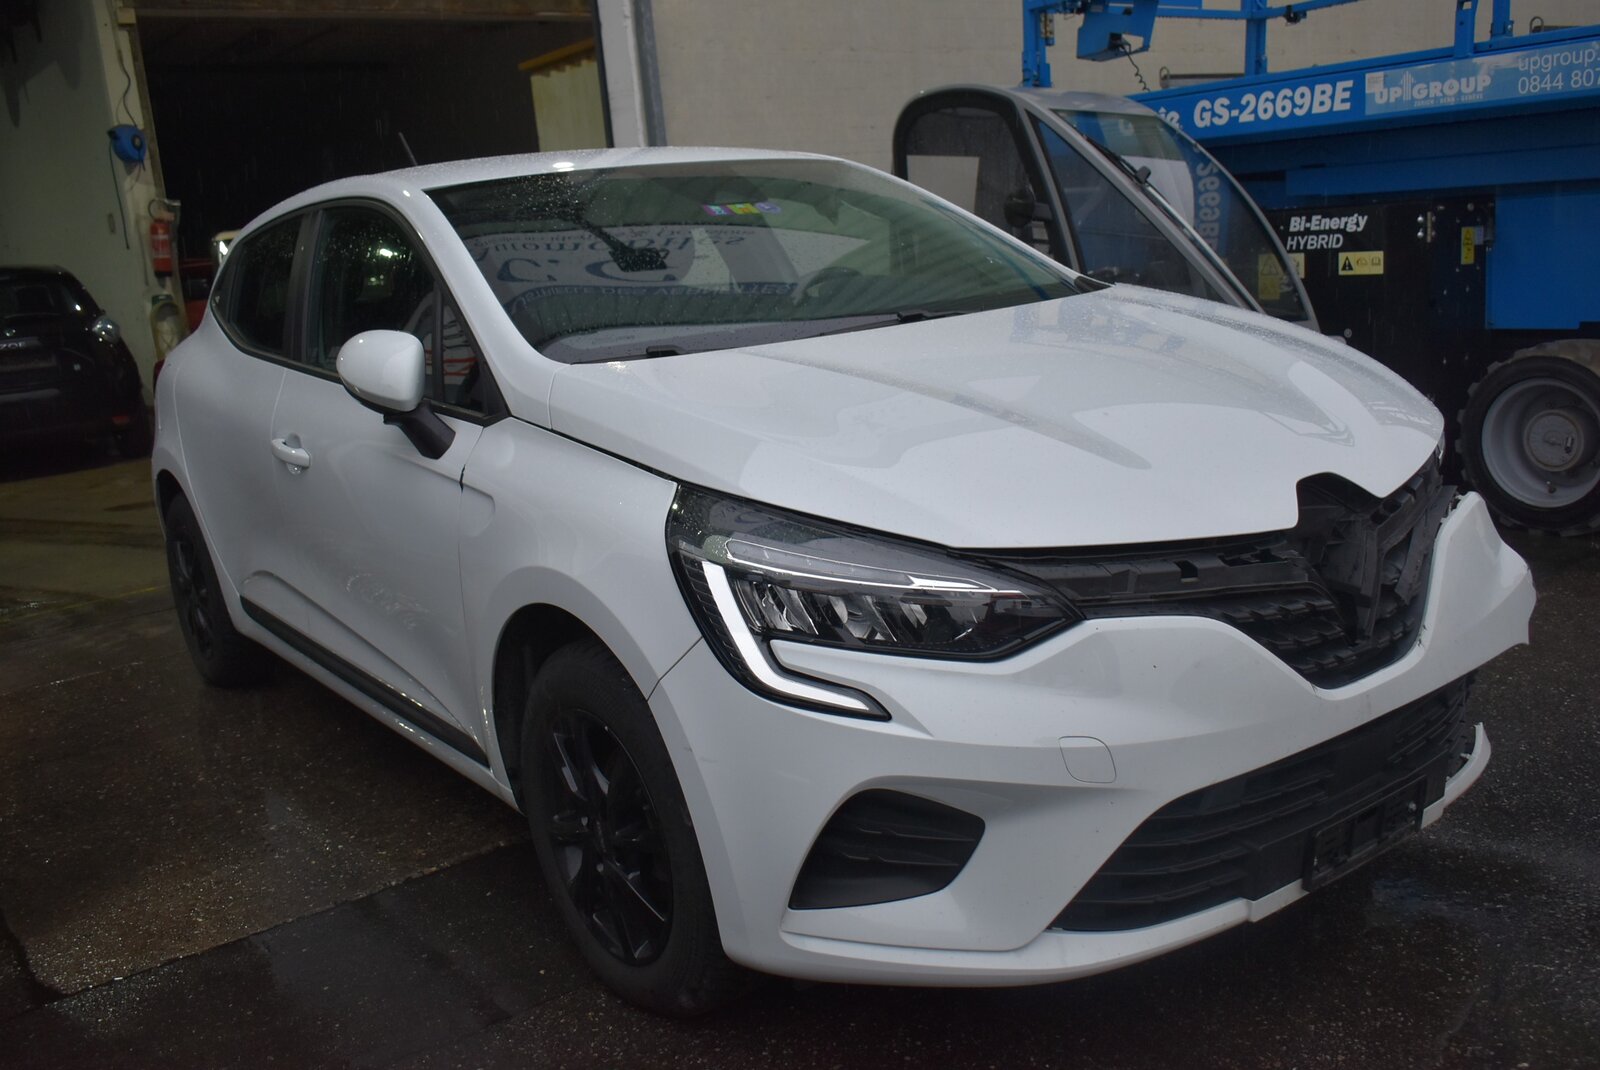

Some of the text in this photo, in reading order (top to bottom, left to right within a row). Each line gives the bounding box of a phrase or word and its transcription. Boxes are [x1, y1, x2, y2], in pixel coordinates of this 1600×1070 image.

[1518, 72, 1564, 94] 0844
[1193, 80, 1354, 128] GS-2669BE
[1289, 213, 1368, 232] Bi-Energy
[1286, 234, 1343, 251] HYBRID
